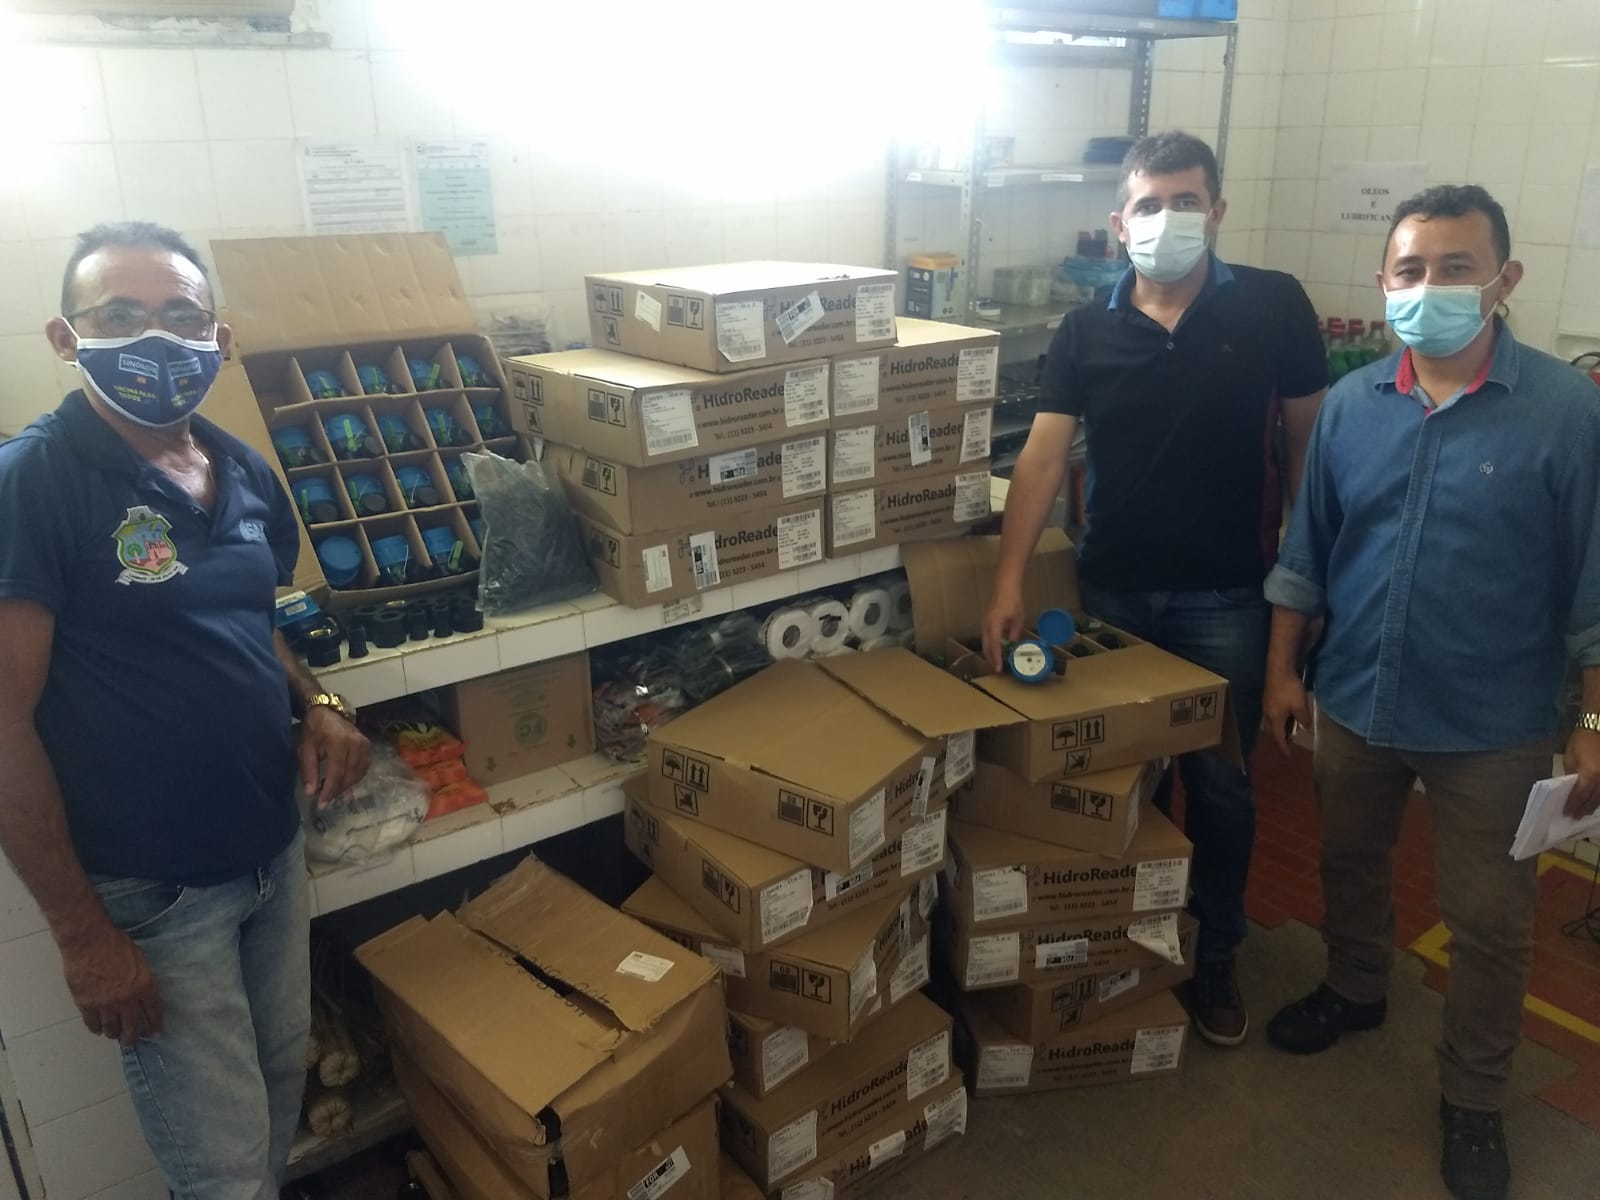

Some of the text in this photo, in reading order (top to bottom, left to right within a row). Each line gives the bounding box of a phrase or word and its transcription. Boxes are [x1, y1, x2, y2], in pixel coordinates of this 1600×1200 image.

[891, 352, 960, 375] HidroReade
[703, 382, 785, 409] HidroReade
[887, 483, 957, 509] HidroReade
[1043, 864, 1137, 885] HidroReade
[1049, 1039, 1136, 1060] HidroReade
[831, 1059, 908, 1115] HidroReade
